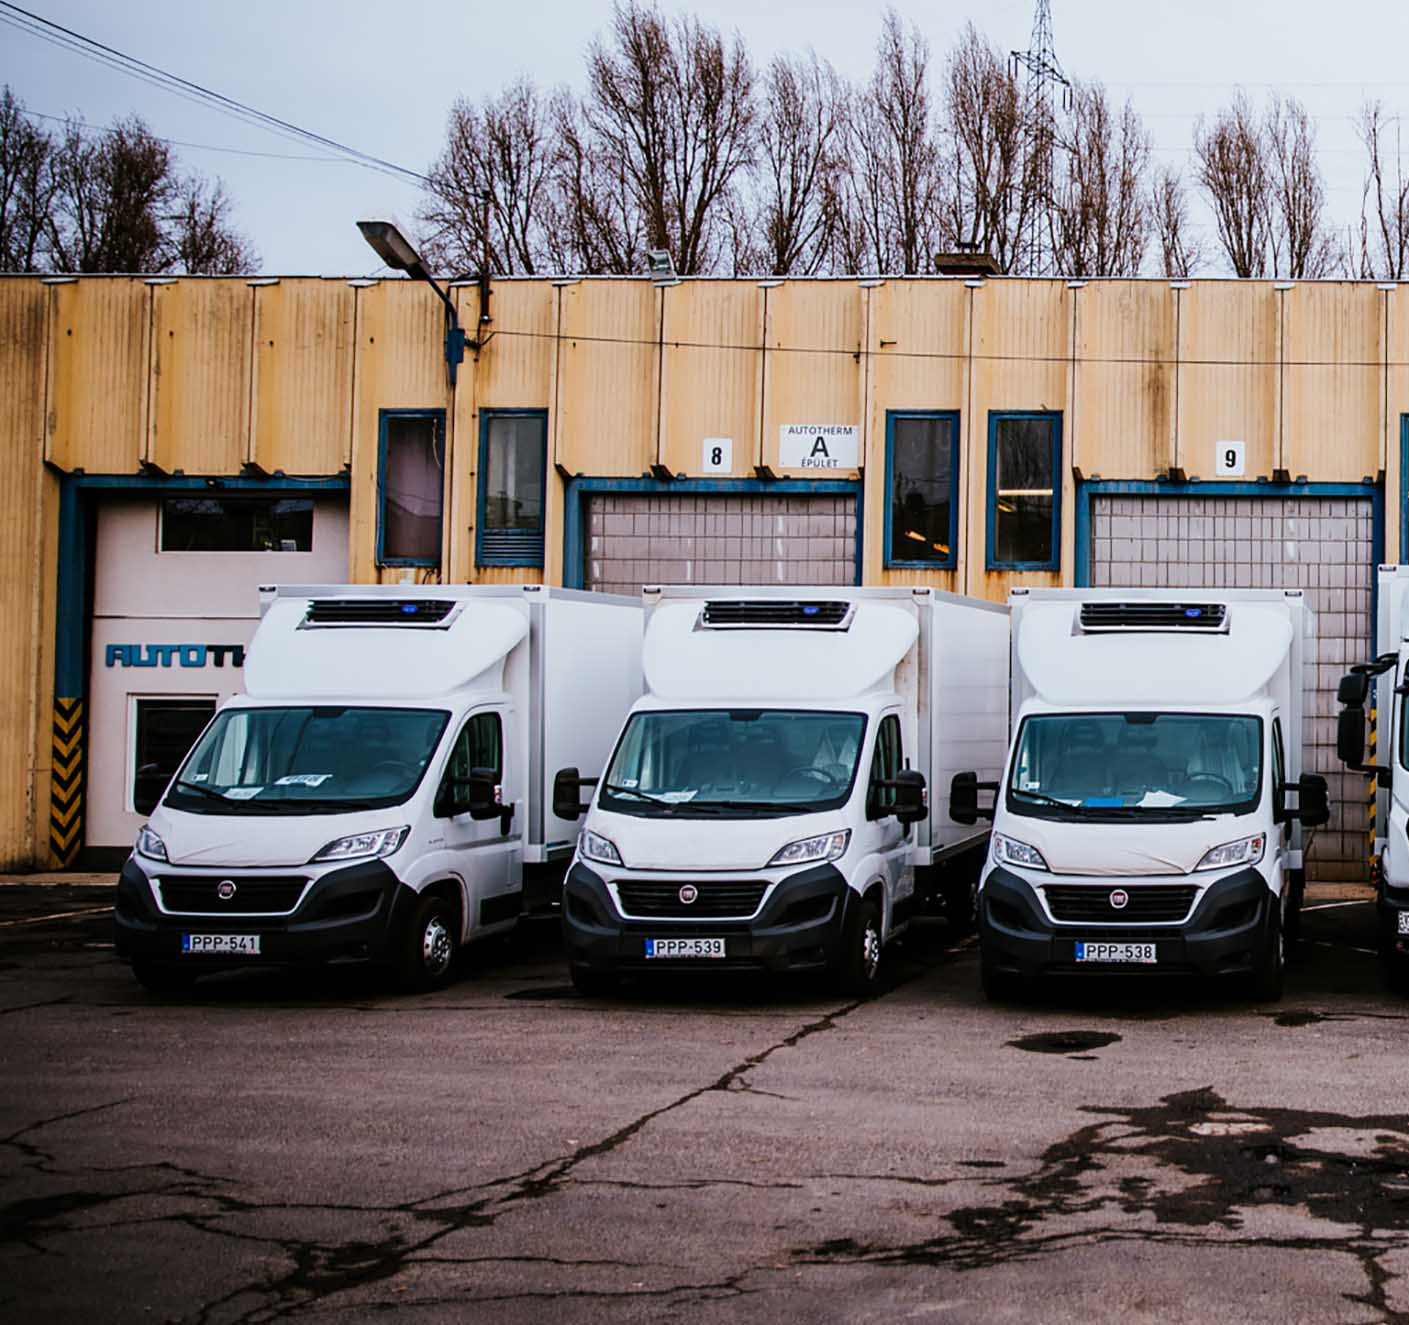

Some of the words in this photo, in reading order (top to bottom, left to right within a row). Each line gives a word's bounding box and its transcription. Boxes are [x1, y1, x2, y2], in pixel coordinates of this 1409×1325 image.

[788, 426, 853, 435] AUTOTHERM
[810, 436, 829, 457] A
[711, 446, 722, 465] 8
[1225, 449, 1236, 468] 9
[801, 458, 839, 468] ÉPÜLET
[192, 936, 255, 950] PPP-541
[656, 940, 721, 954] PPP-539
[1087, 945, 1153, 958] PPP-538
